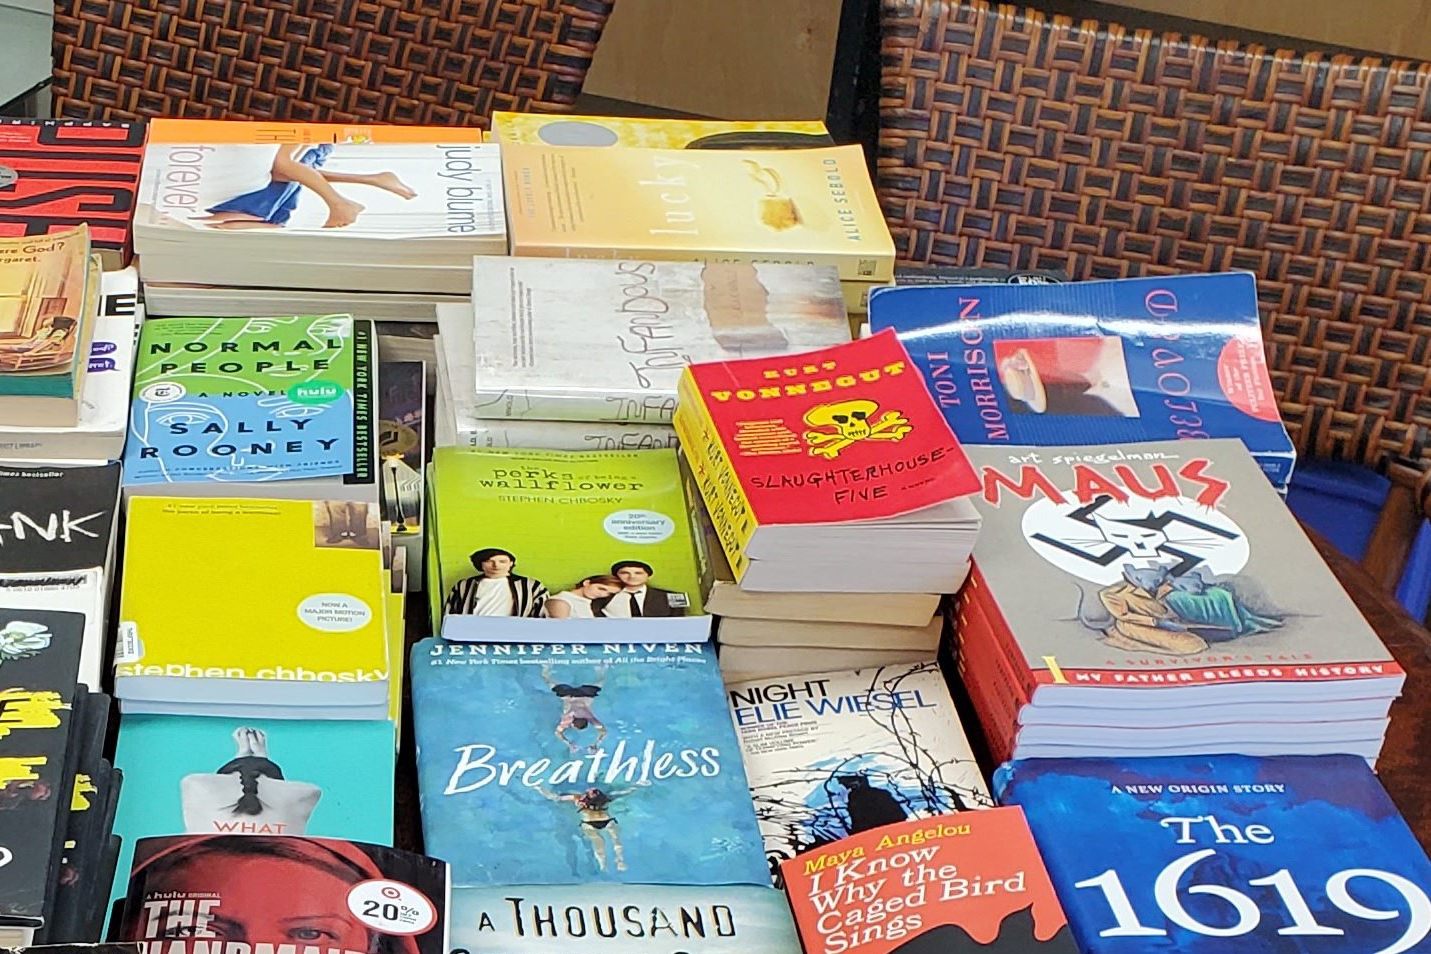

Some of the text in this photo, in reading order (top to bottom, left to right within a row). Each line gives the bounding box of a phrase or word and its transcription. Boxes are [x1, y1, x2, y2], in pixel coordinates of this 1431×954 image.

[437, 145, 482, 233] judy blume
[823, 158, 860, 241] ALICE SEBOLD
[23, 242, 65, 254] God?
[150, 339, 343, 354] NORMAL
[161, 359, 329, 375] PEOPLE
[711, 361, 906, 402] VONNEGUT
[763, 360, 837, 379] KURT
[927, 351, 961, 407] TONI
[958, 296, 1010, 440] MORRISON
[297, 385, 336, 397] hulu
[170, 418, 312, 435] SALLY
[140, 438, 339, 458] ROONEY
[1008, 449, 1179, 465] art spiegelman
[479, 479, 644, 491] wallflower
[493, 468, 573, 482] perks
[980, 459, 1229, 509] MAUS
[834, 486, 888, 505] FIVE
[429, 642, 702, 657] JENNIFER NIVEN
[1076, 664, 1385, 684] MY FATHER BLEEDS HISTORY
[729, 679, 830, 708] NIGHT
[735, 689, 937, 726] ELIE WIESEL
[443, 739, 720, 795] Breathless
[1112, 783, 1286, 795] A NEW ORIGIN STORY
[213, 820, 287, 834] WHAT
[1160, 815, 1275, 845] The
[803, 823, 971, 877] Maya Angelou
[807, 846, 941, 898] I Know
[810, 865, 957, 916] Why the
[816, 872, 1026, 936] Caged Bird
[144, 899, 221, 939] THE
[479, 897, 737, 939] A THOUSAND
